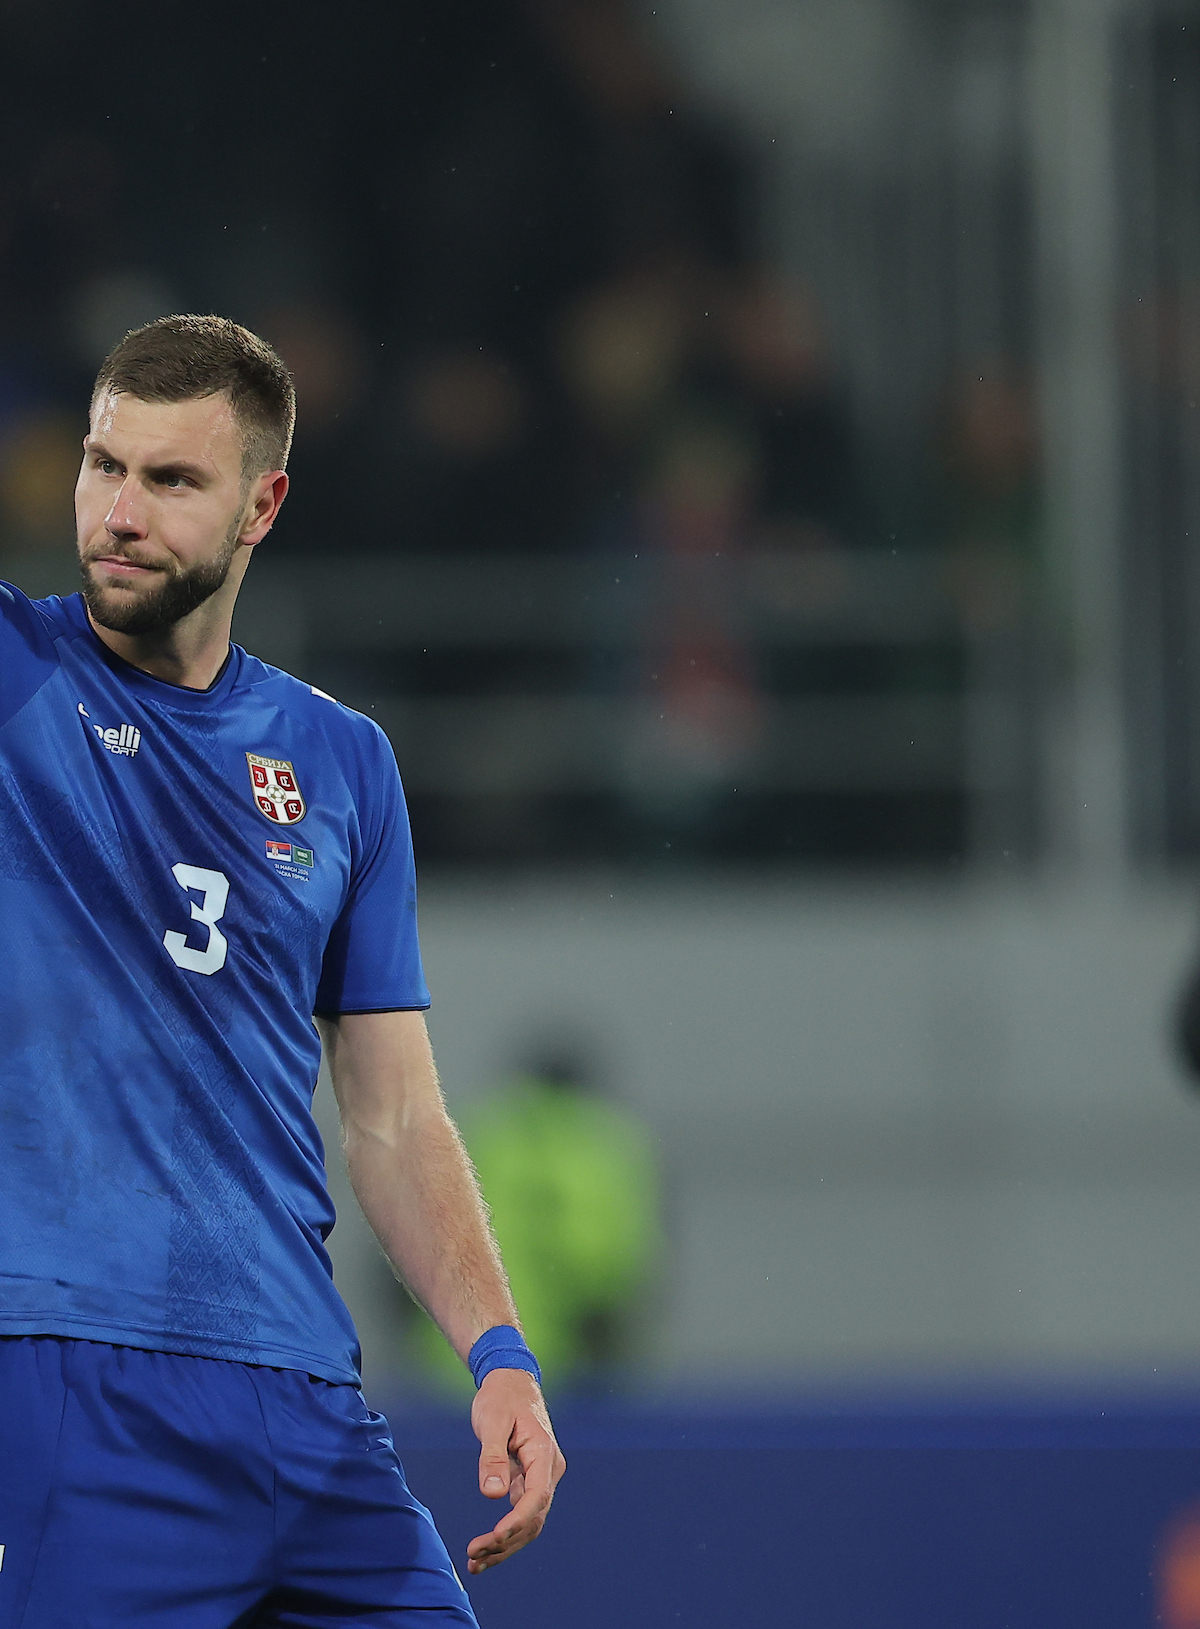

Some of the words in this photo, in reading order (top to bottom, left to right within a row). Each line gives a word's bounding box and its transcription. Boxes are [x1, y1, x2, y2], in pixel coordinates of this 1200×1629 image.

[103, 743, 138, 757] PORT
[249, 754, 291, 769] СРБИЈА
[280, 865, 298, 873] MARCH
[163, 862, 230, 975] 3
